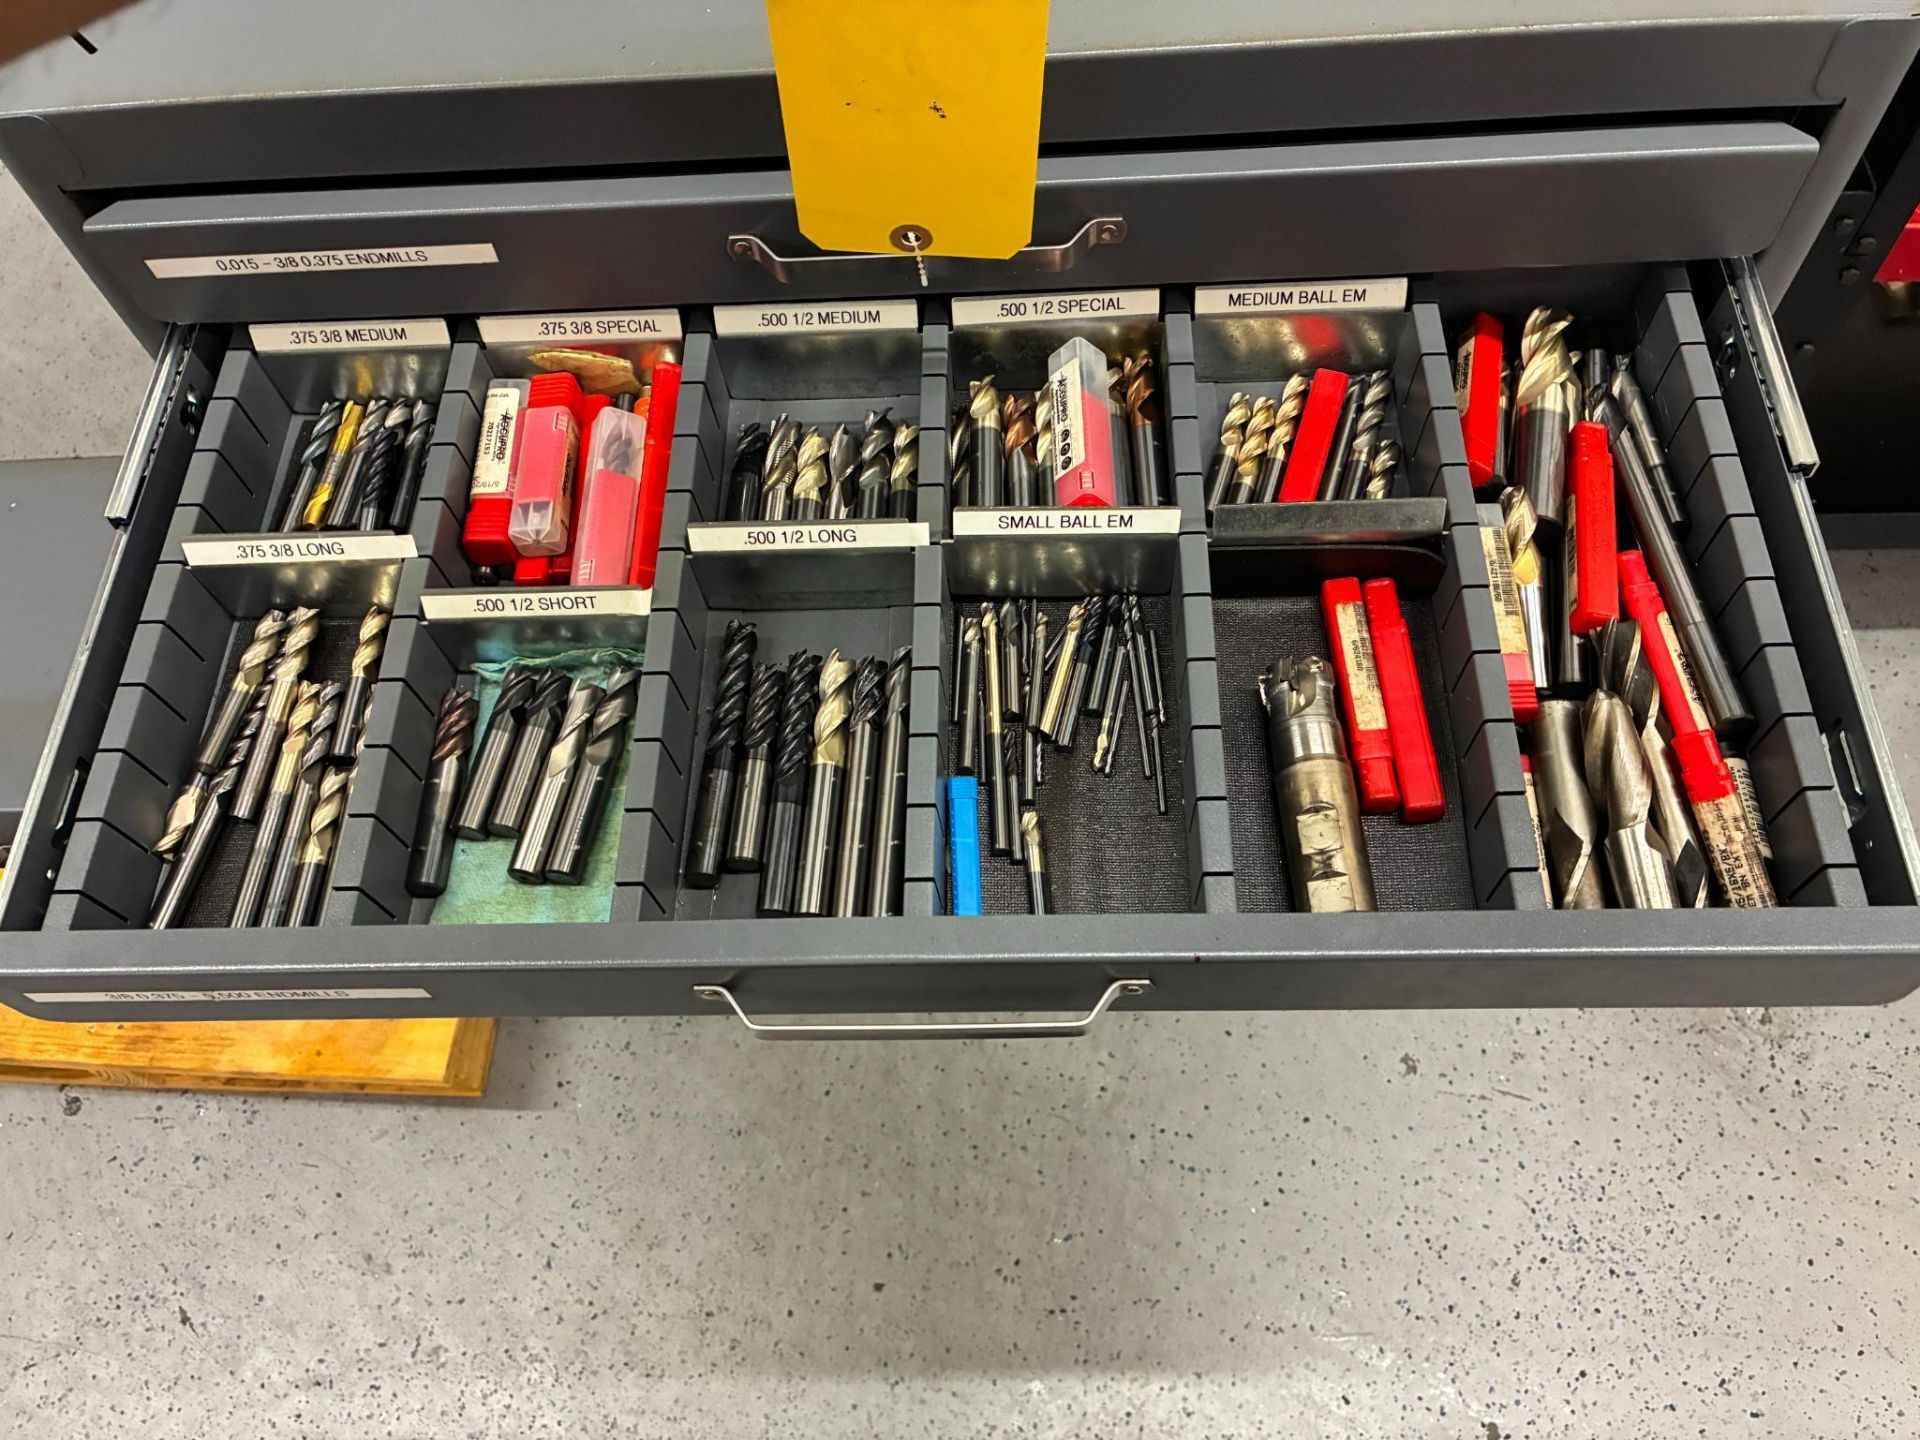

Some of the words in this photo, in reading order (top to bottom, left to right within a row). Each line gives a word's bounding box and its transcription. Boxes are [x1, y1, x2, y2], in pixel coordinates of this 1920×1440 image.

[216, 258, 260, 272] 0.015
[274, 255, 299, 269] 3/8
[300, 253, 343, 267] 0.375
[345, 250, 428, 265] ENDMILLS
[1228, 291, 1294, 307] MEDIUM
[1298, 289, 1340, 305] BALL
[1343, 288, 1367, 303] EM
[996, 302, 1027, 318] .500
[1032, 301, 1054, 316] 1/2
[1057, 297, 1125, 314] SPECIAL
[537, 321, 567, 336] .375
[570, 320, 593, 334] 3/8
[596, 318, 662, 334] SPECIAL
[757, 312, 788, 328] .500
[792, 311, 814, 327] 1/2
[818, 310, 881, 326] MEDIUM
[289, 330, 318, 345] .375
[320, 329, 342, 344] 3/8
[345, 327, 407, 343] MEDIUM
[496, 408, 513, 463] ACCUPRO
[998, 515, 1055, 530] SMALL
[1059, 515, 1103, 529] BALL
[1107, 514, 1134, 528] EM
[744, 530, 776, 546] .500
[781, 529, 804, 545] 1/2
[808, 528, 857, 544] LONG
[236, 543, 266, 558] .375
[269, 543, 294, 558] 3/8
[298, 541, 345, 557] LONG
[473, 597, 505, 612] .500
[510, 597, 535, 612] 1/2
[539, 595, 597, 611] SHORT
